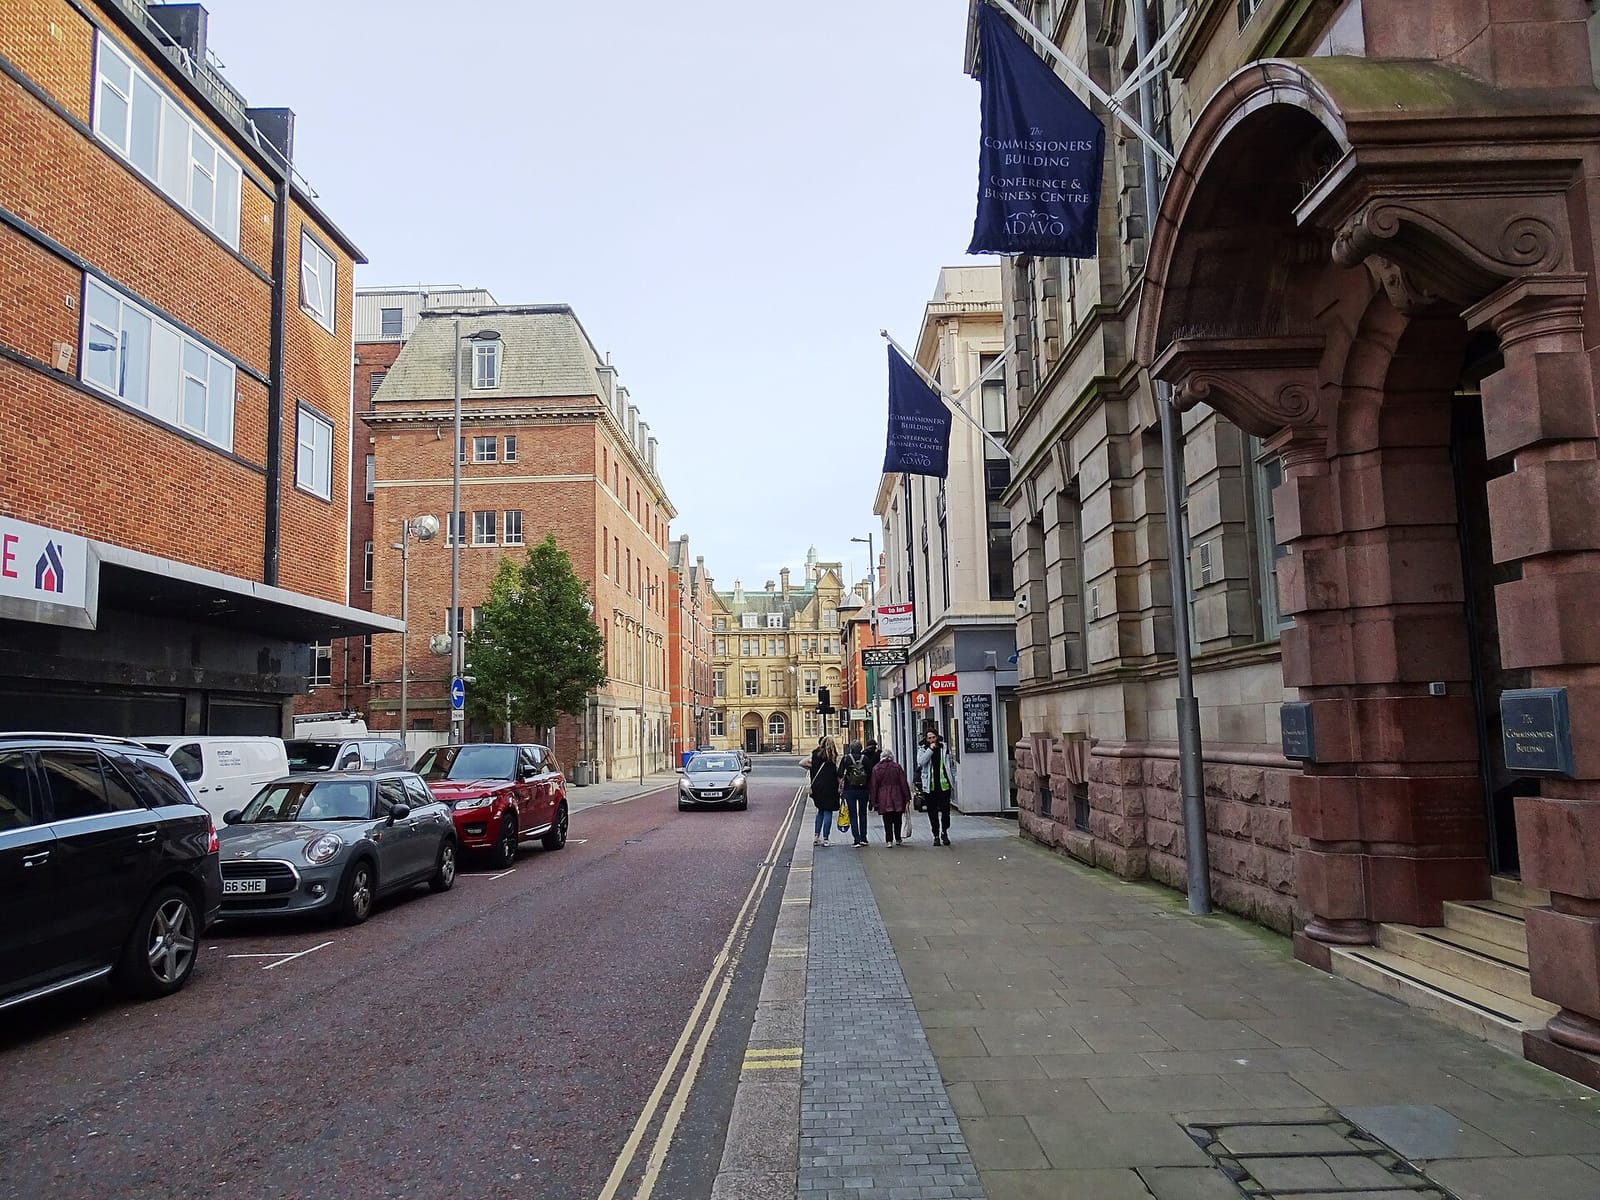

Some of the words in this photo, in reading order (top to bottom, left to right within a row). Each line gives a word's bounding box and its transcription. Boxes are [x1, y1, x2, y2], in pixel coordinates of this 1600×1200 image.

[1030, 127, 1043, 136] The
[984, 136, 1092, 152] COMMISSIONERS
[1005, 154, 1070, 167] BUILDING
[990, 174, 1067, 189] CONFERENCE
[1070, 178, 1081, 189] &
[984, 188, 1037, 201] BUSINESS
[1040, 191, 1089, 204] CENTRE
[1003, 220, 1064, 236] ADAVO
[890, 413, 945, 425] COMMISSIONERS
[901, 422, 934, 432] BUILDING
[2, 533, 19, 578] E
[240, 880, 262, 891] SHE
